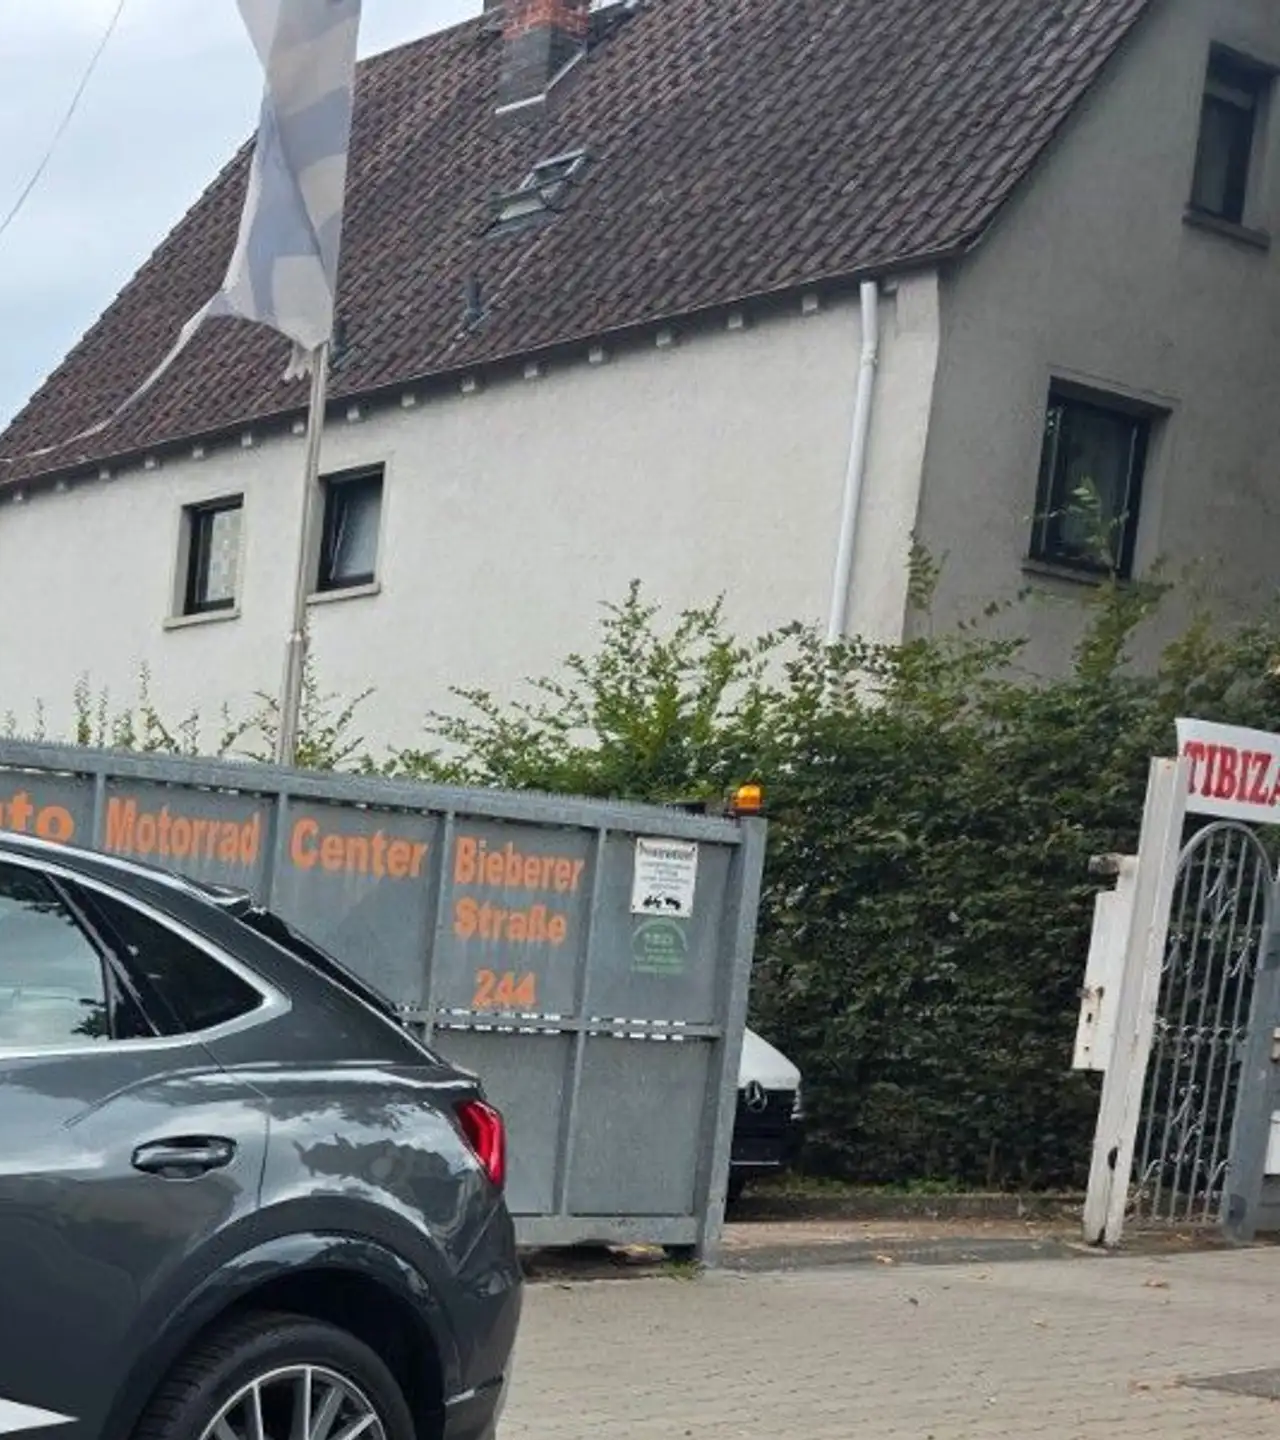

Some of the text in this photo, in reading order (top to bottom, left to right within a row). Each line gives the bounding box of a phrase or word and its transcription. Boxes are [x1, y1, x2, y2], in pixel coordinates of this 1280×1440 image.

[105, 796, 261, 864] Motorrad
[290, 817, 429, 878] Center
[454, 836, 585, 891] Bieberer
[454, 896, 567, 944] Straße
[472, 969, 537, 1010] 244
